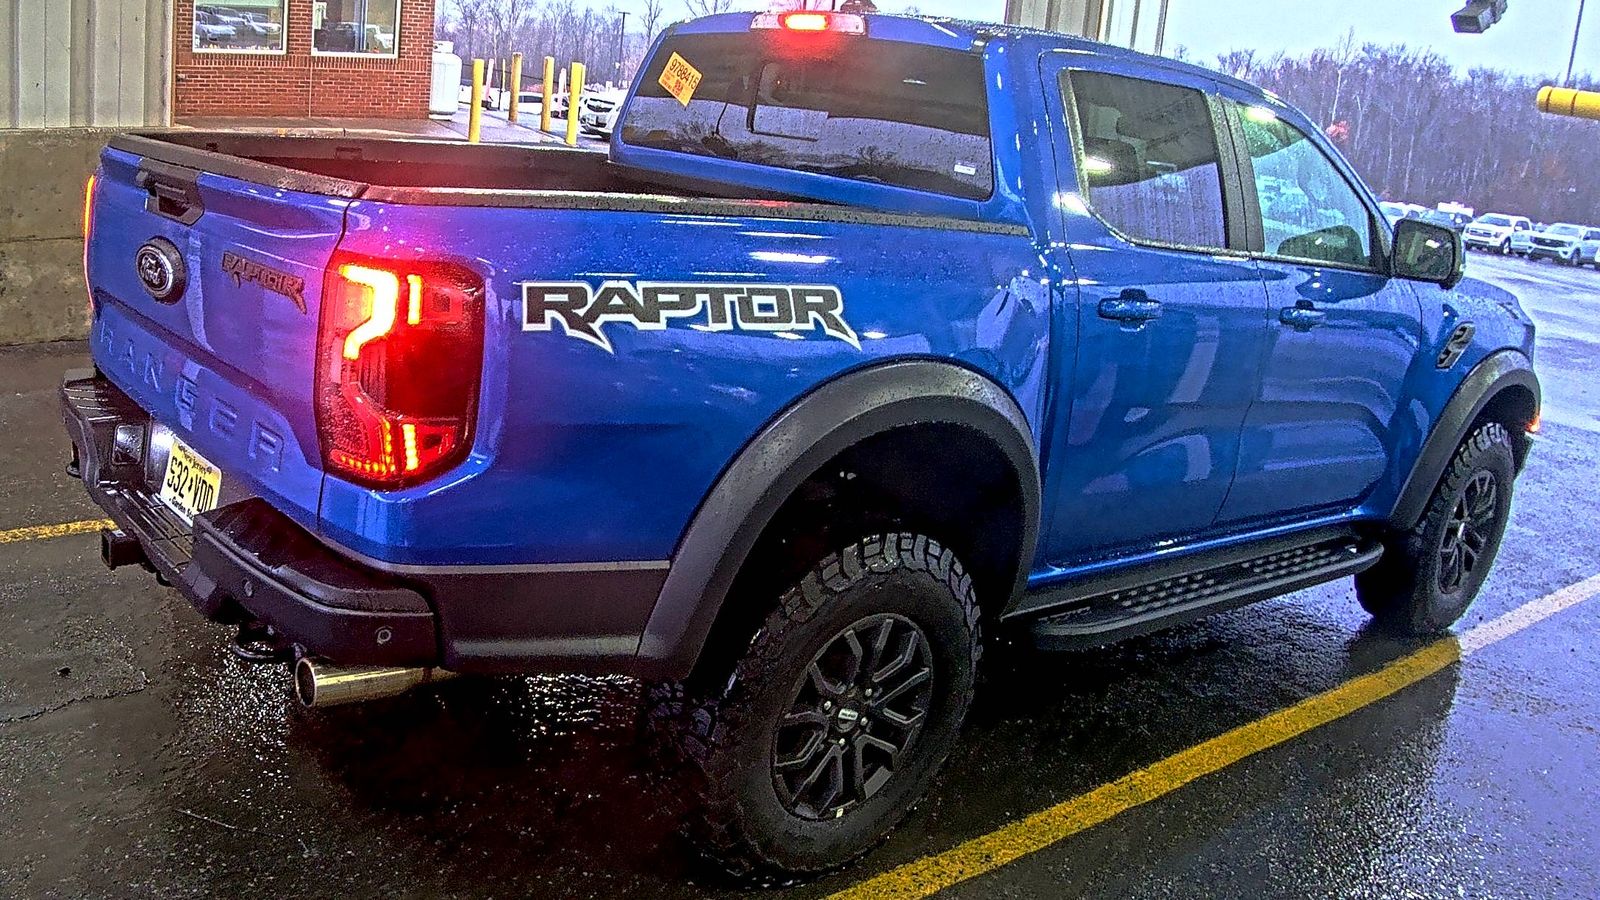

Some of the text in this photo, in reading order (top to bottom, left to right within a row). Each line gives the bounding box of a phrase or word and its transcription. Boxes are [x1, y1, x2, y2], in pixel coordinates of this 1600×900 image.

[669, 58, 700, 90] 9788415
[140, 254, 161, 285] Ford
[222, 251, 307, 315] RAPTOR
[521, 280, 862, 354] RAPTOR
[99, 318, 285, 475] RANGER
[171, 496, 187, 514] Garden
